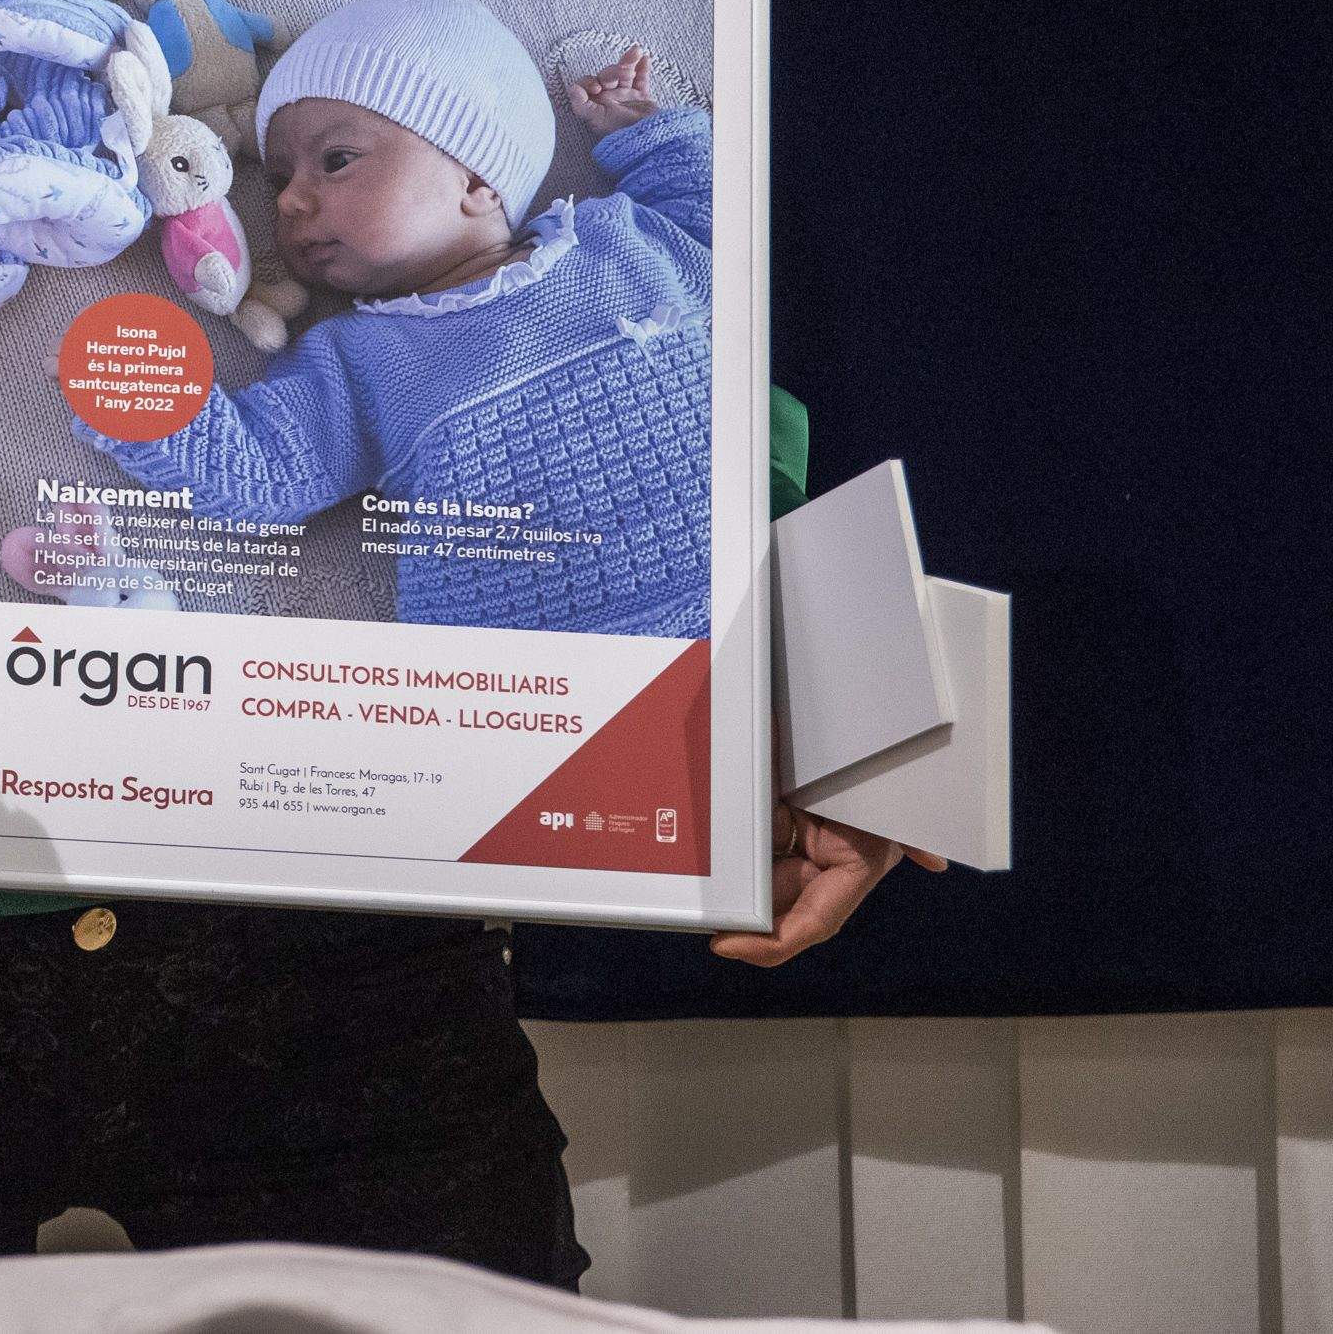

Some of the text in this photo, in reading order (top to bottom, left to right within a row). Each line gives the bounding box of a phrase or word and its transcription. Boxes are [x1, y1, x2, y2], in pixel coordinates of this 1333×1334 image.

[117, 325, 157, 339] Isona
[87, 341, 186, 360] Herrero Pujol
[88, 359, 183, 376] és la primera
[69, 378, 202, 395] santcugatenca de
[135, 397, 174, 412] 2022
[37, 479, 193, 510] Naixement
[362, 494, 535, 520] Com és la Isona?
[36, 508, 306, 537] La Isona va néixer el dia 1 de gener
[362, 519, 602, 545] El nadó va pesar 2,7 quilos i va
[35, 530, 300, 556] a les set i dos minuts de la tarda a
[362, 541, 555, 563] mesurar 47 centímetres
[114, 554, 208, 571] Universitari
[211, 557, 275, 575] General
[278, 562, 298, 577] de
[34, 570, 233, 596] Catalunya de Sant Cugat
[242, 660, 569, 696] CONSULTORS IMMOBILIARIS
[183, 697, 210, 711] 1967
[241, 697, 342, 721] COMPRA
[358, 703, 440, 726] VENDA
[459, 709, 583, 734] LLOGUERS
[240, 763, 264, 774] Sant
[267, 764, 300, 778] Cugat
[311, 766, 355, 780] Francesc
[359, 769, 410, 784] Moragas,
[1, 769, 213, 809] Resposta Segura
[274, 781, 289, 794] Pg.
[293, 782, 306, 793] de
[309, 783, 322, 794] les
[326, 784, 358, 797] Torres,
[362, 787, 376, 797] 47
[239, 799, 258, 809] 935
[262, 800, 280, 810] 441
[283, 801, 303, 811] 655
[313, 803, 386, 816] www.organ.es
